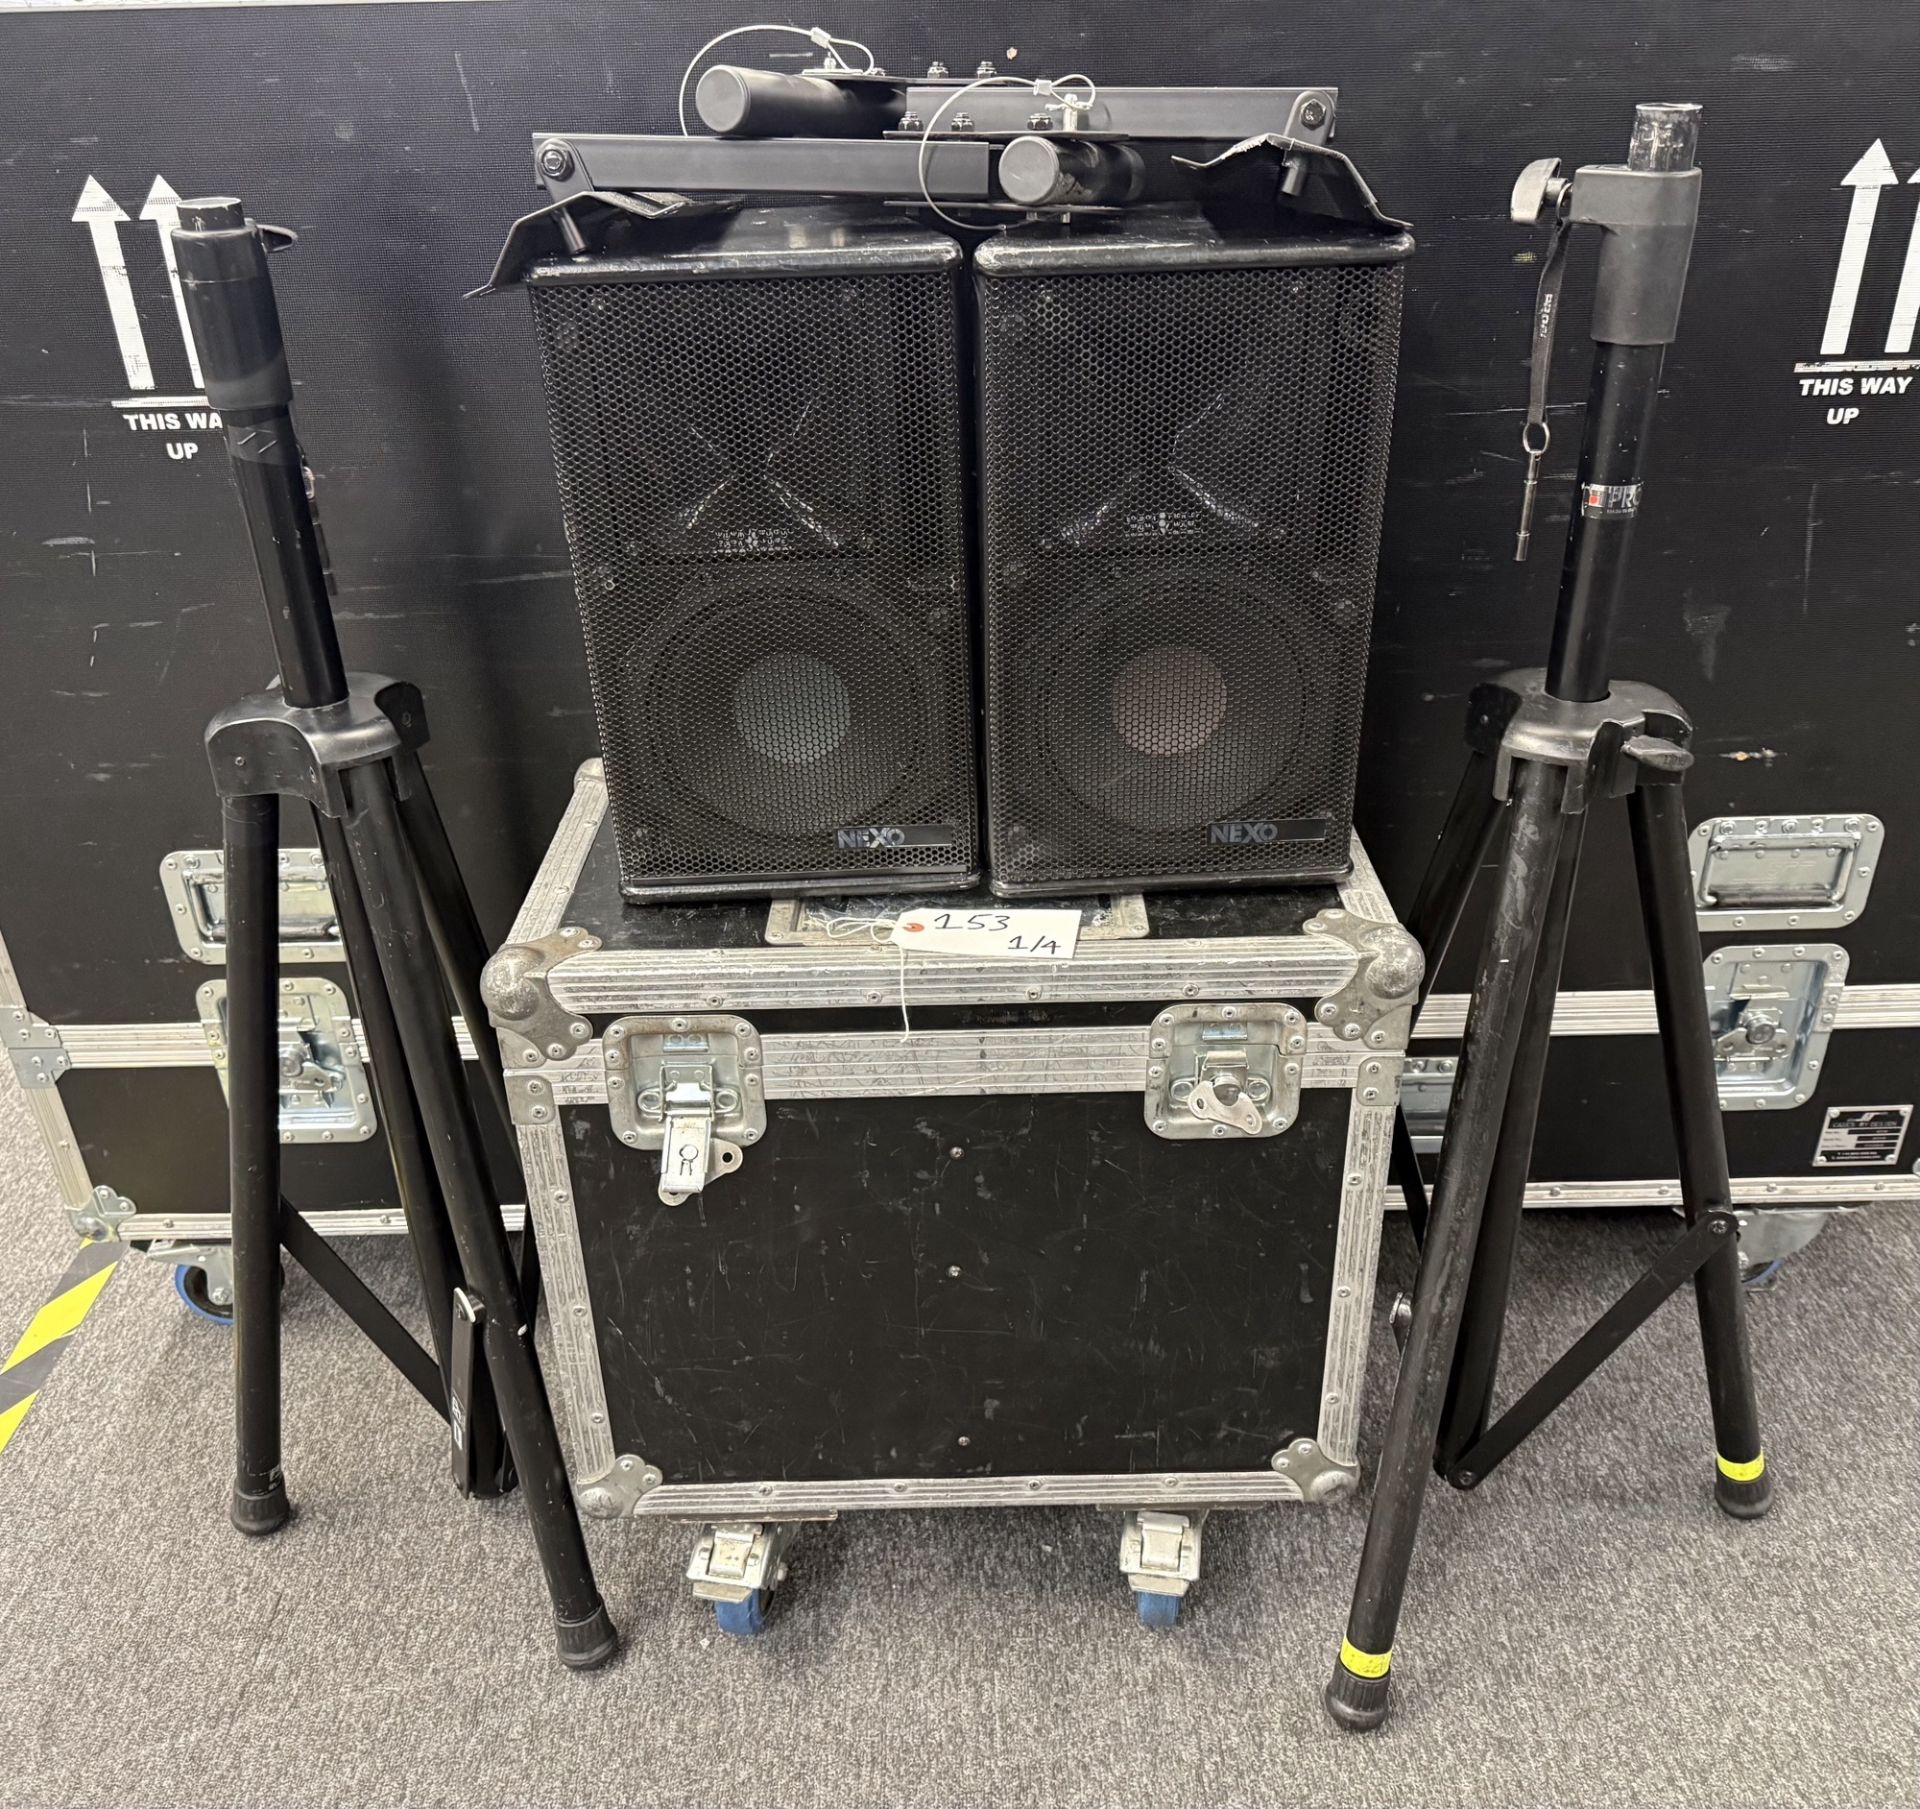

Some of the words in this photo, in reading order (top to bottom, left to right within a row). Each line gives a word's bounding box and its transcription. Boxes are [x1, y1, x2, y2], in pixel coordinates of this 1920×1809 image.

[1799, 378, 1854, 396] THIS
[1860, 376, 1913, 395] WAY
[122, 413, 181, 431] THIS
[184, 412, 223, 430] WA
[1826, 407, 1860, 425] UP
[165, 442, 199, 460] UP
[837, 827, 905, 849] NEXO
[1210, 822, 1278, 844] NEXO
[933, 913, 1011, 932] 153
[1007, 935, 1062, 955] 1/4
